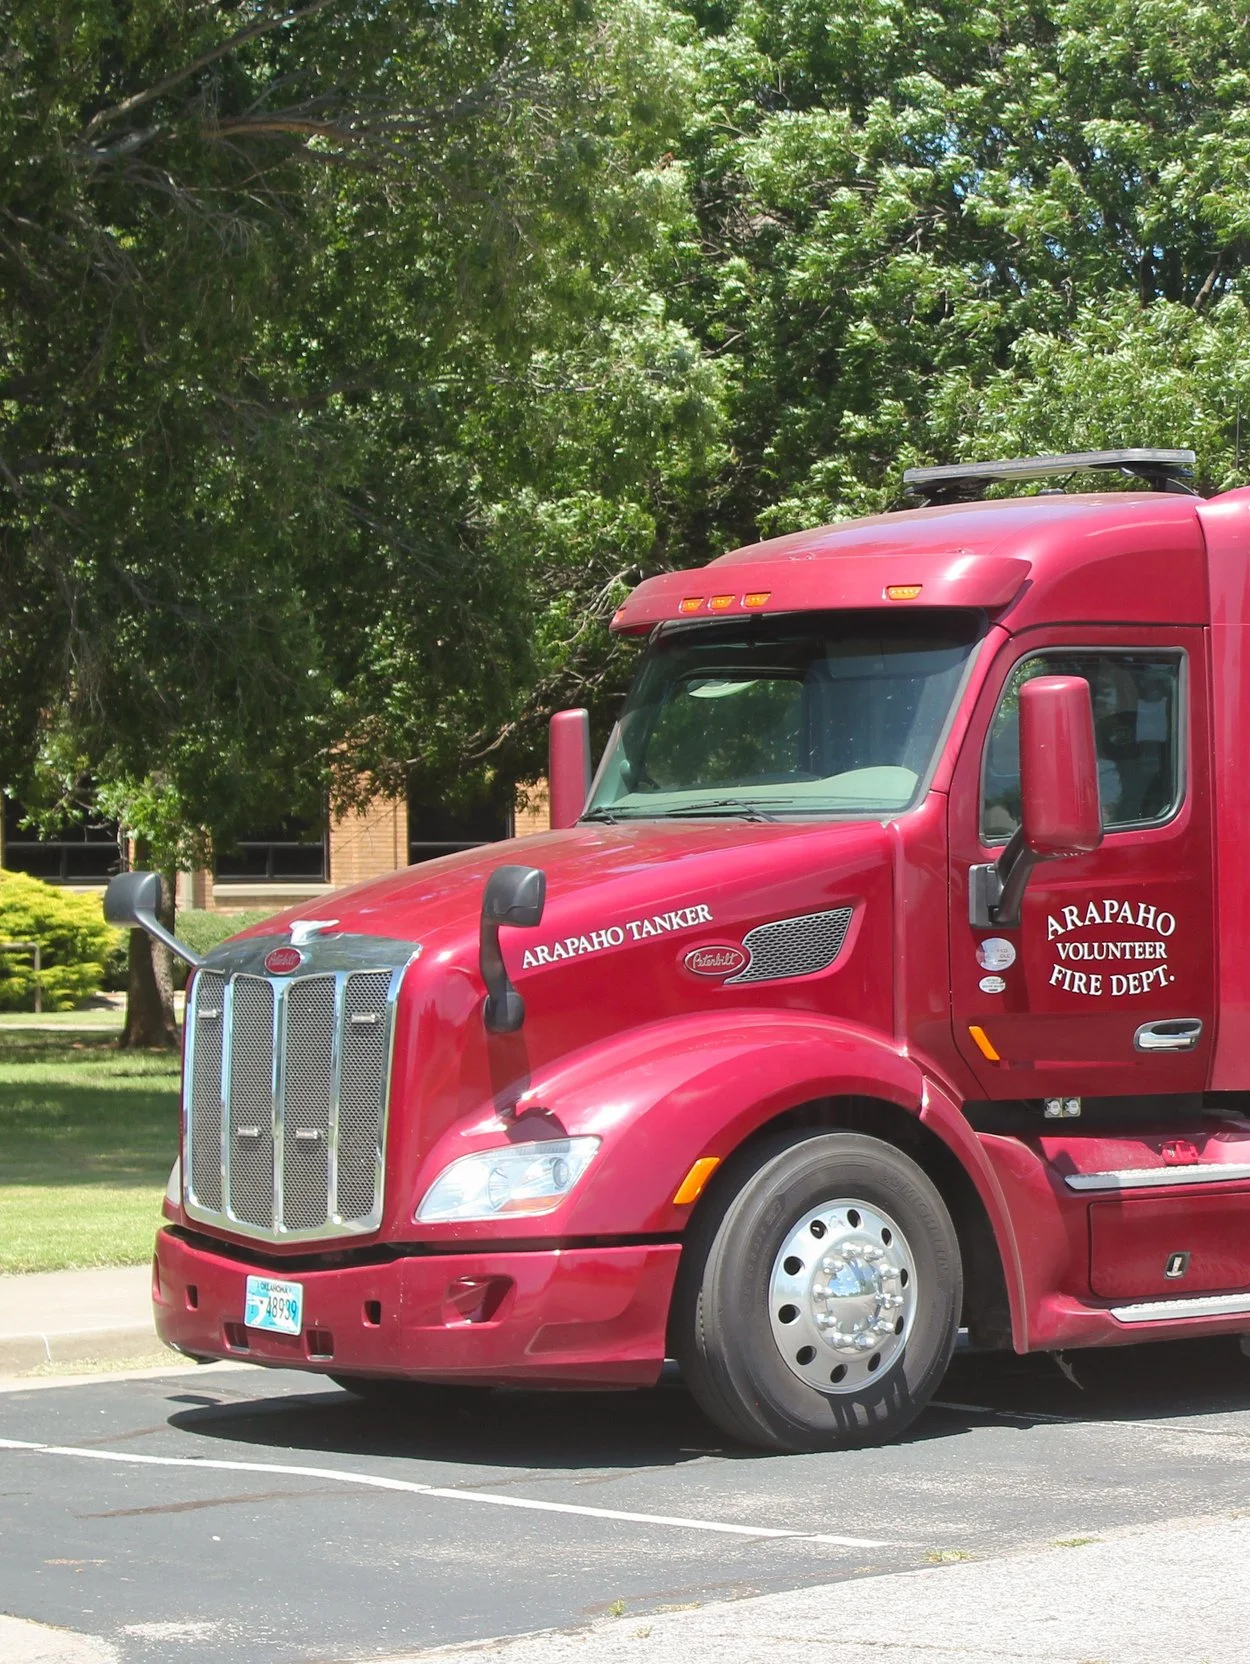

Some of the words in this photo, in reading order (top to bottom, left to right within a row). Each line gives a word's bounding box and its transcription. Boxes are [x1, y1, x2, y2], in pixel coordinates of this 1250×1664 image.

[1047, 900, 1176, 941] ARAPAHO
[522, 926, 624, 969] ARAPAHO
[625, 903, 714, 940] TANKER
[692, 952, 739, 969] Peterbilt
[1056, 941, 1168, 961] VOLUNTEER
[1049, 963, 1103, 996] FIRE
[1110, 964, 1175, 996] DEPT.
[260, 1282, 289, 1294] OKLAHOMA
[266, 1296, 298, 1321] 48939
